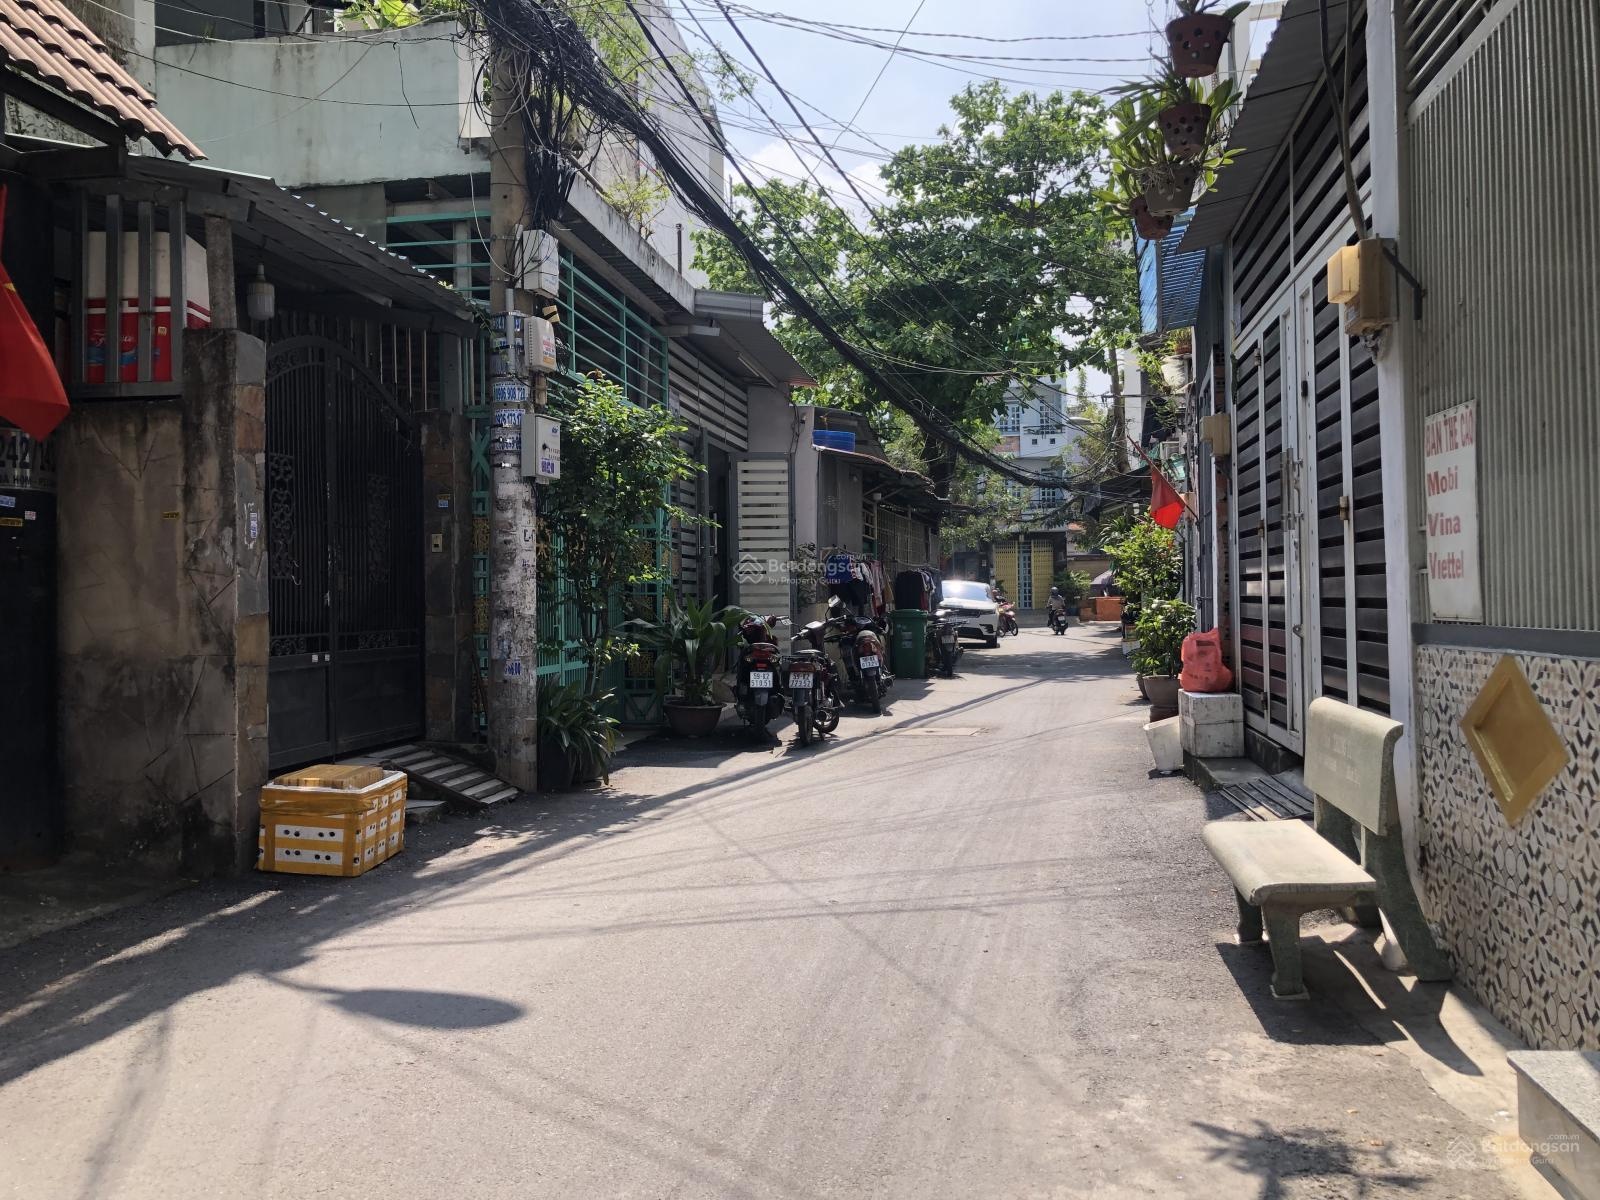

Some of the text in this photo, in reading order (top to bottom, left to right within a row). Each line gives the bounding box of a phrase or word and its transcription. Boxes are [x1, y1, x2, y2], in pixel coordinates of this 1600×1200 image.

[1427, 465, 1458, 496] Mobi
[1428, 512, 1461, 536] Vina
[1429, 549, 1464, 580] Viettel
